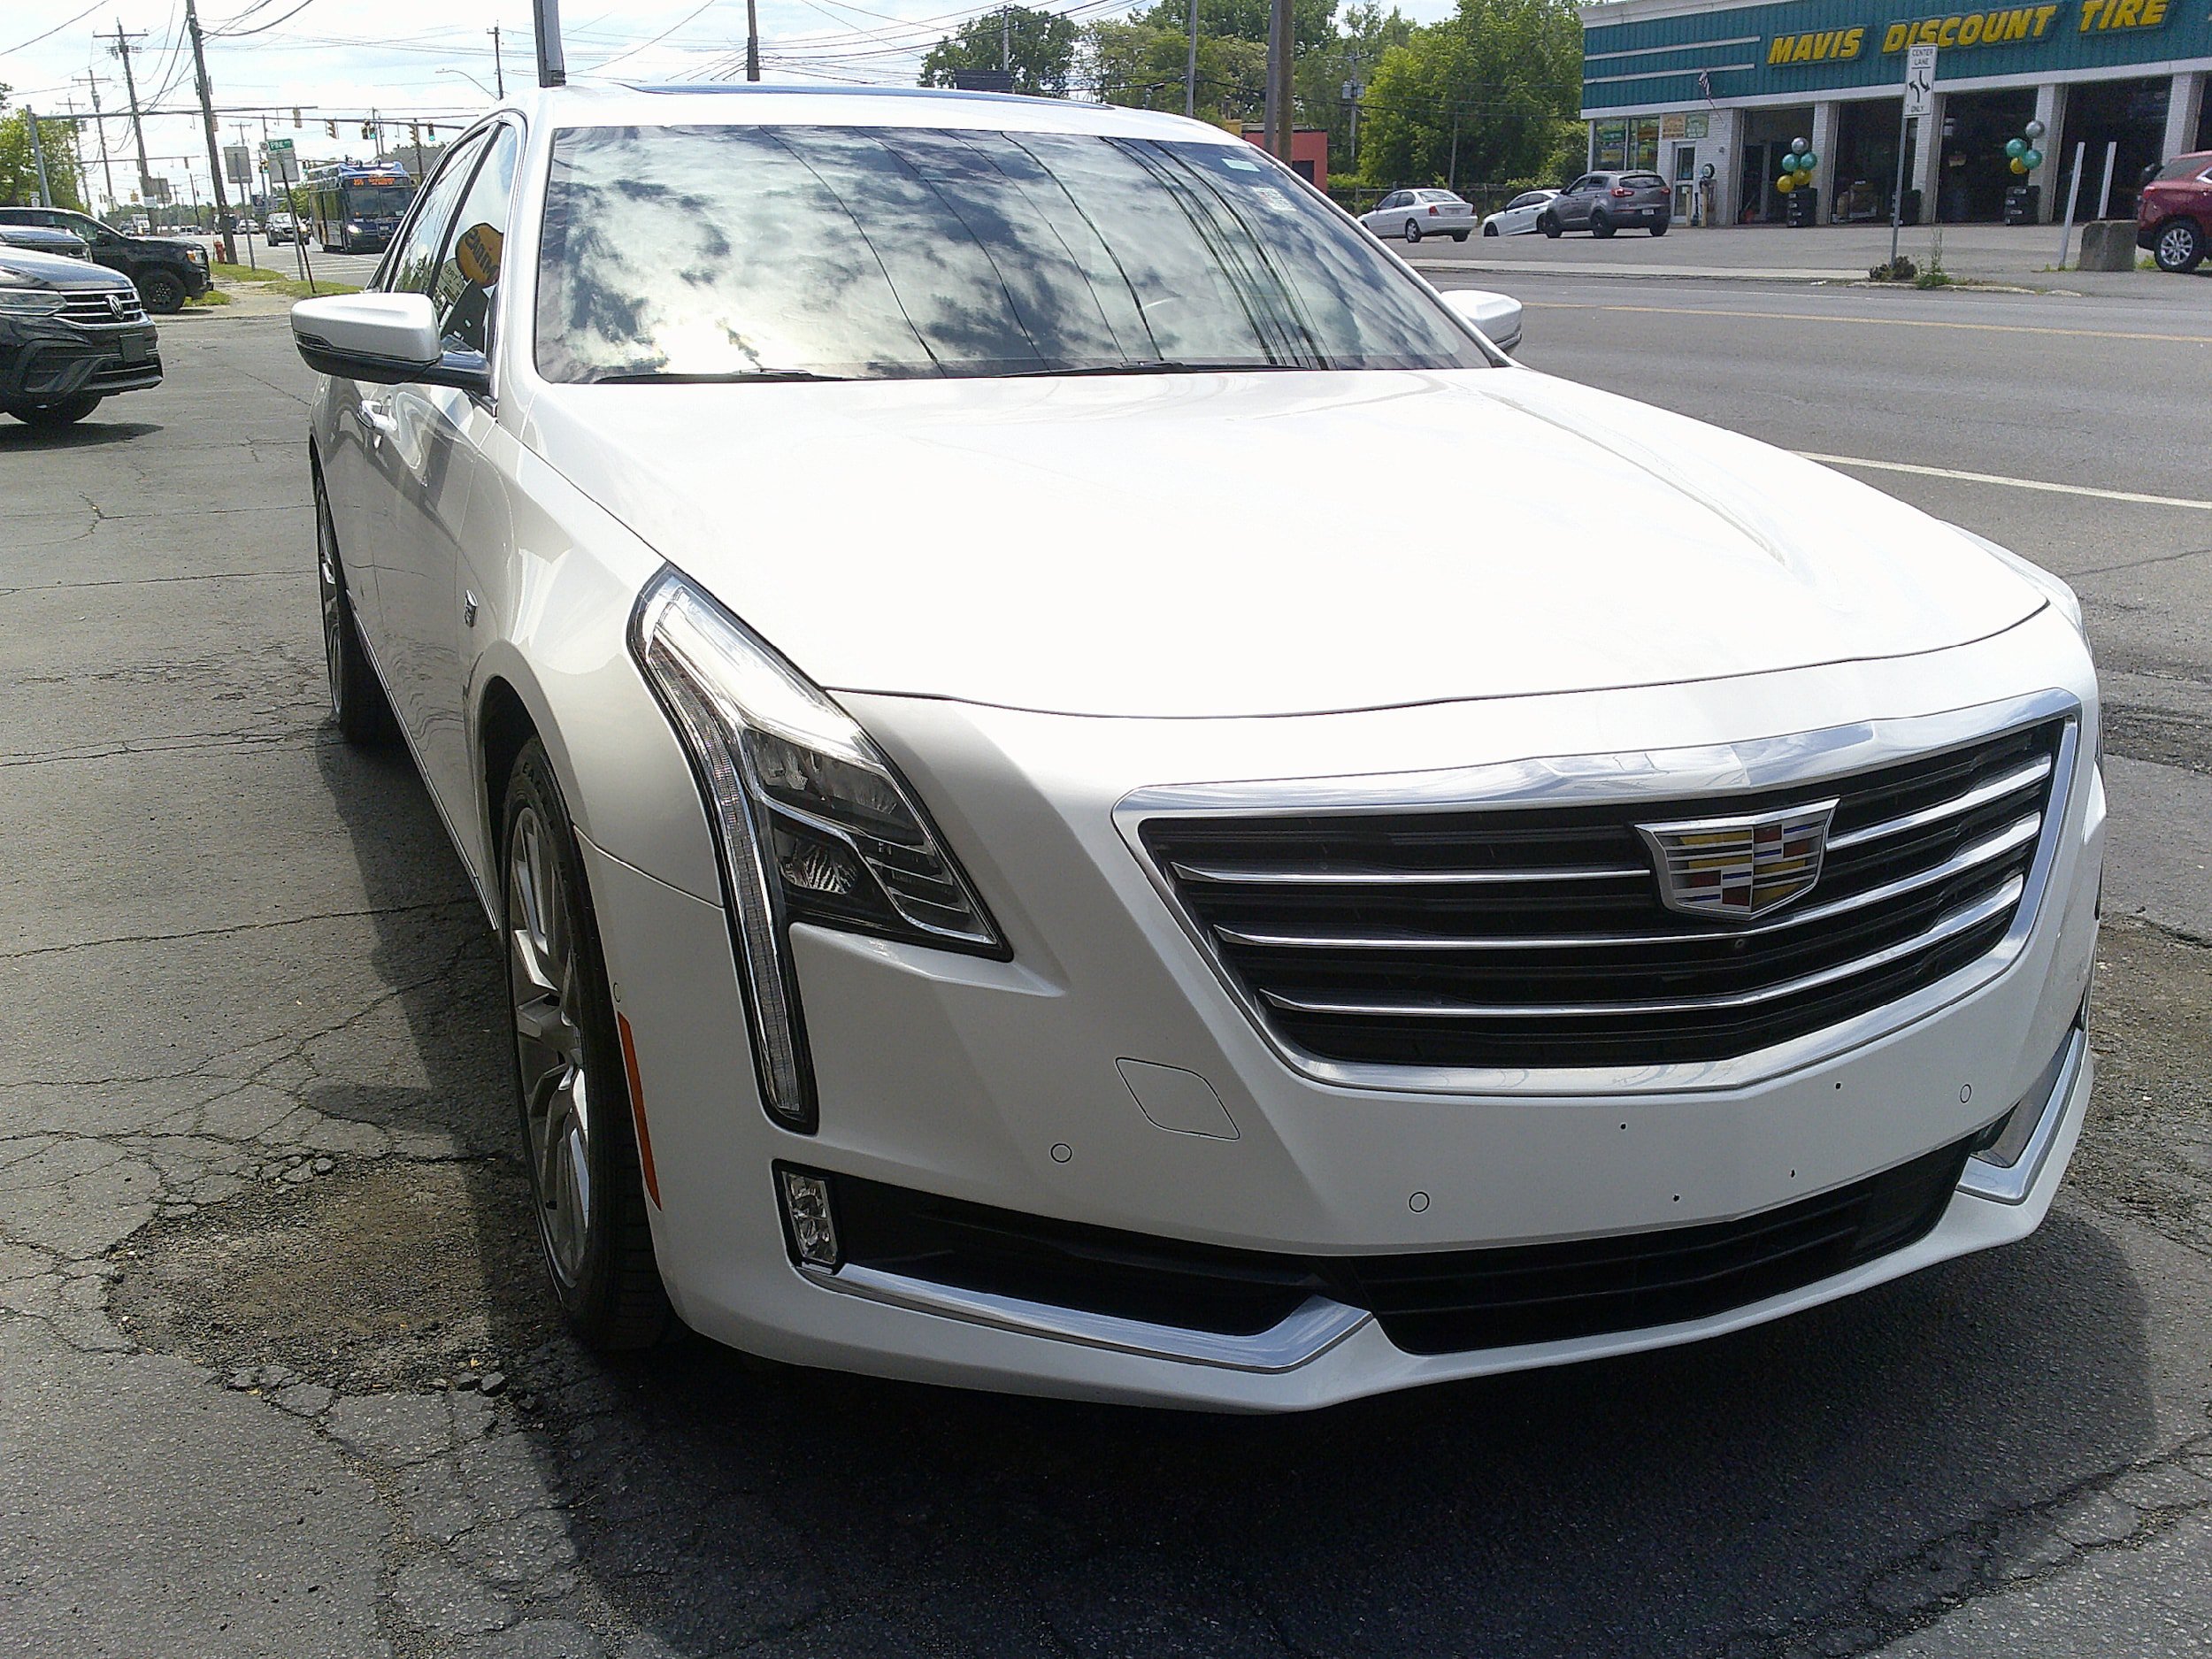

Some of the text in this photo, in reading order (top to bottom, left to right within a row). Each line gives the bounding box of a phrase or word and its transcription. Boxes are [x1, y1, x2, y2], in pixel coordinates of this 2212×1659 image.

[1768, 0, 2169, 64] MAVIS DISCOUNT TIRE
